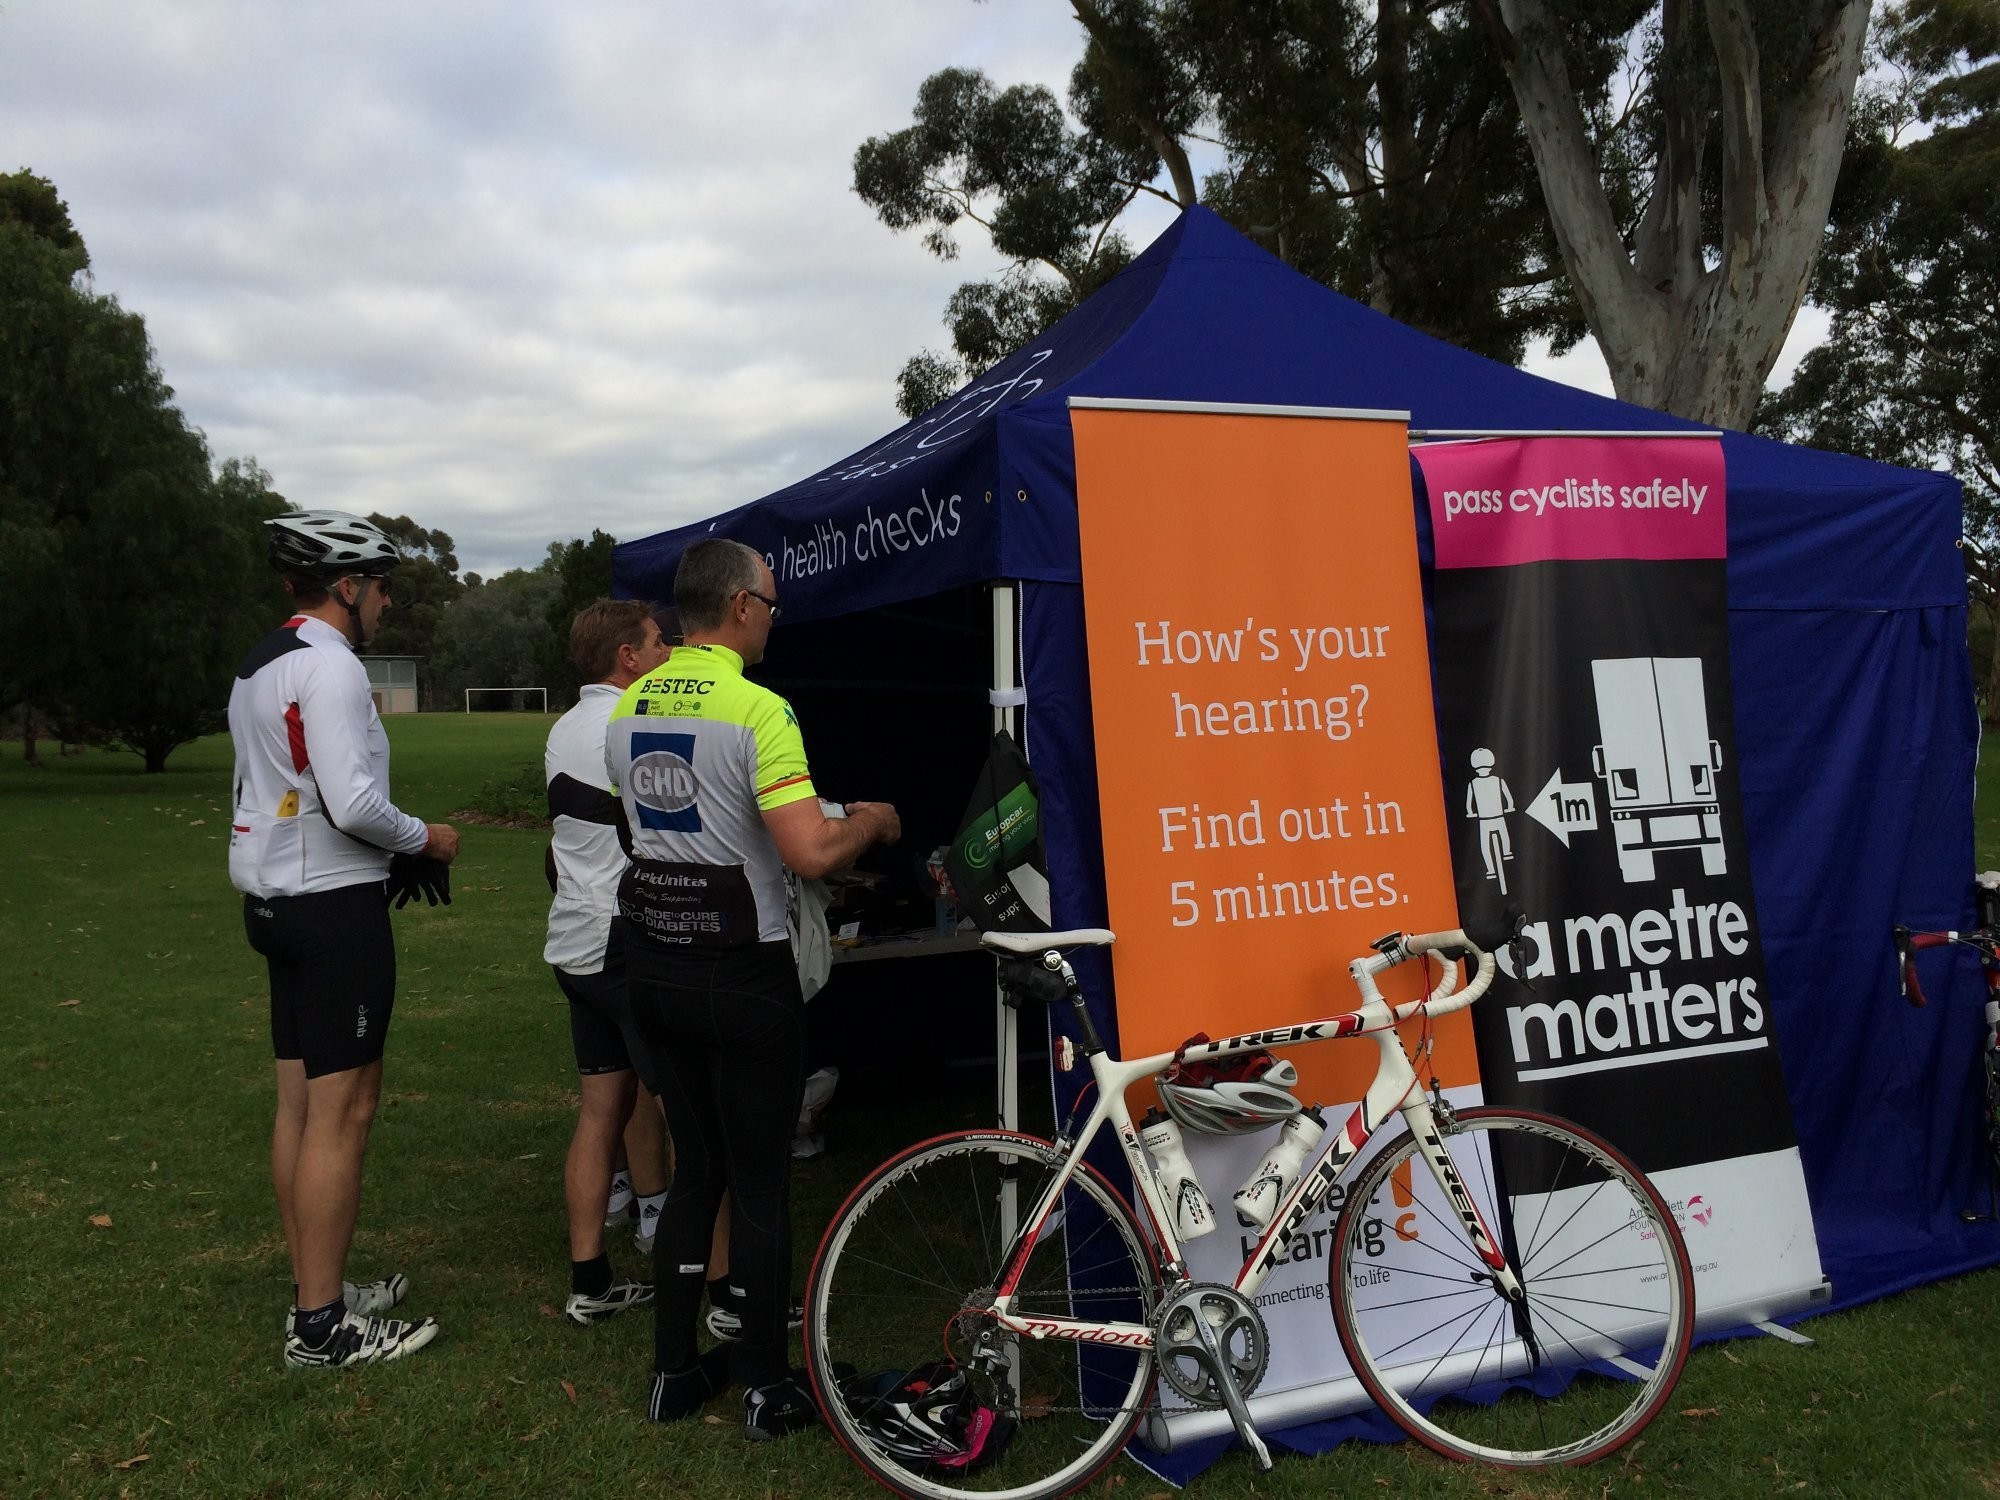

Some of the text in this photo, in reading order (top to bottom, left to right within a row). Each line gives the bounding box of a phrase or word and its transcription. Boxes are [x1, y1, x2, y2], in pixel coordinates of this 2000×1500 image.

[1444, 478, 1708, 521] pass cyclists safely
[782, 488, 962, 582] health checks
[1135, 617, 1390, 672] How's your
[640, 678, 715, 695] BESTEC
[1171, 683, 1369, 741] hearing?
[633, 765, 694, 798] GHD
[1549, 791, 1591, 823] 1m
[1158, 791, 1405, 852] Find out in
[644, 907, 672, 920] RIDE
[680, 911, 720, 921] CURE
[645, 915, 721, 933] DIABETES
[1171, 870, 1409, 927] 5 minutes.
[1495, 888, 1749, 980] a metre
[1206, 1024, 1326, 1053] TREK
[1506, 969, 1764, 1063] matters
[1256, 1138, 1352, 1275] TREK
[1425, 1126, 1487, 1242] TREK
[1253, 1283, 1325, 1310] onnecting
[1353, 1274, 1368, 1289] to
[1369, 1269, 1391, 1286] life
